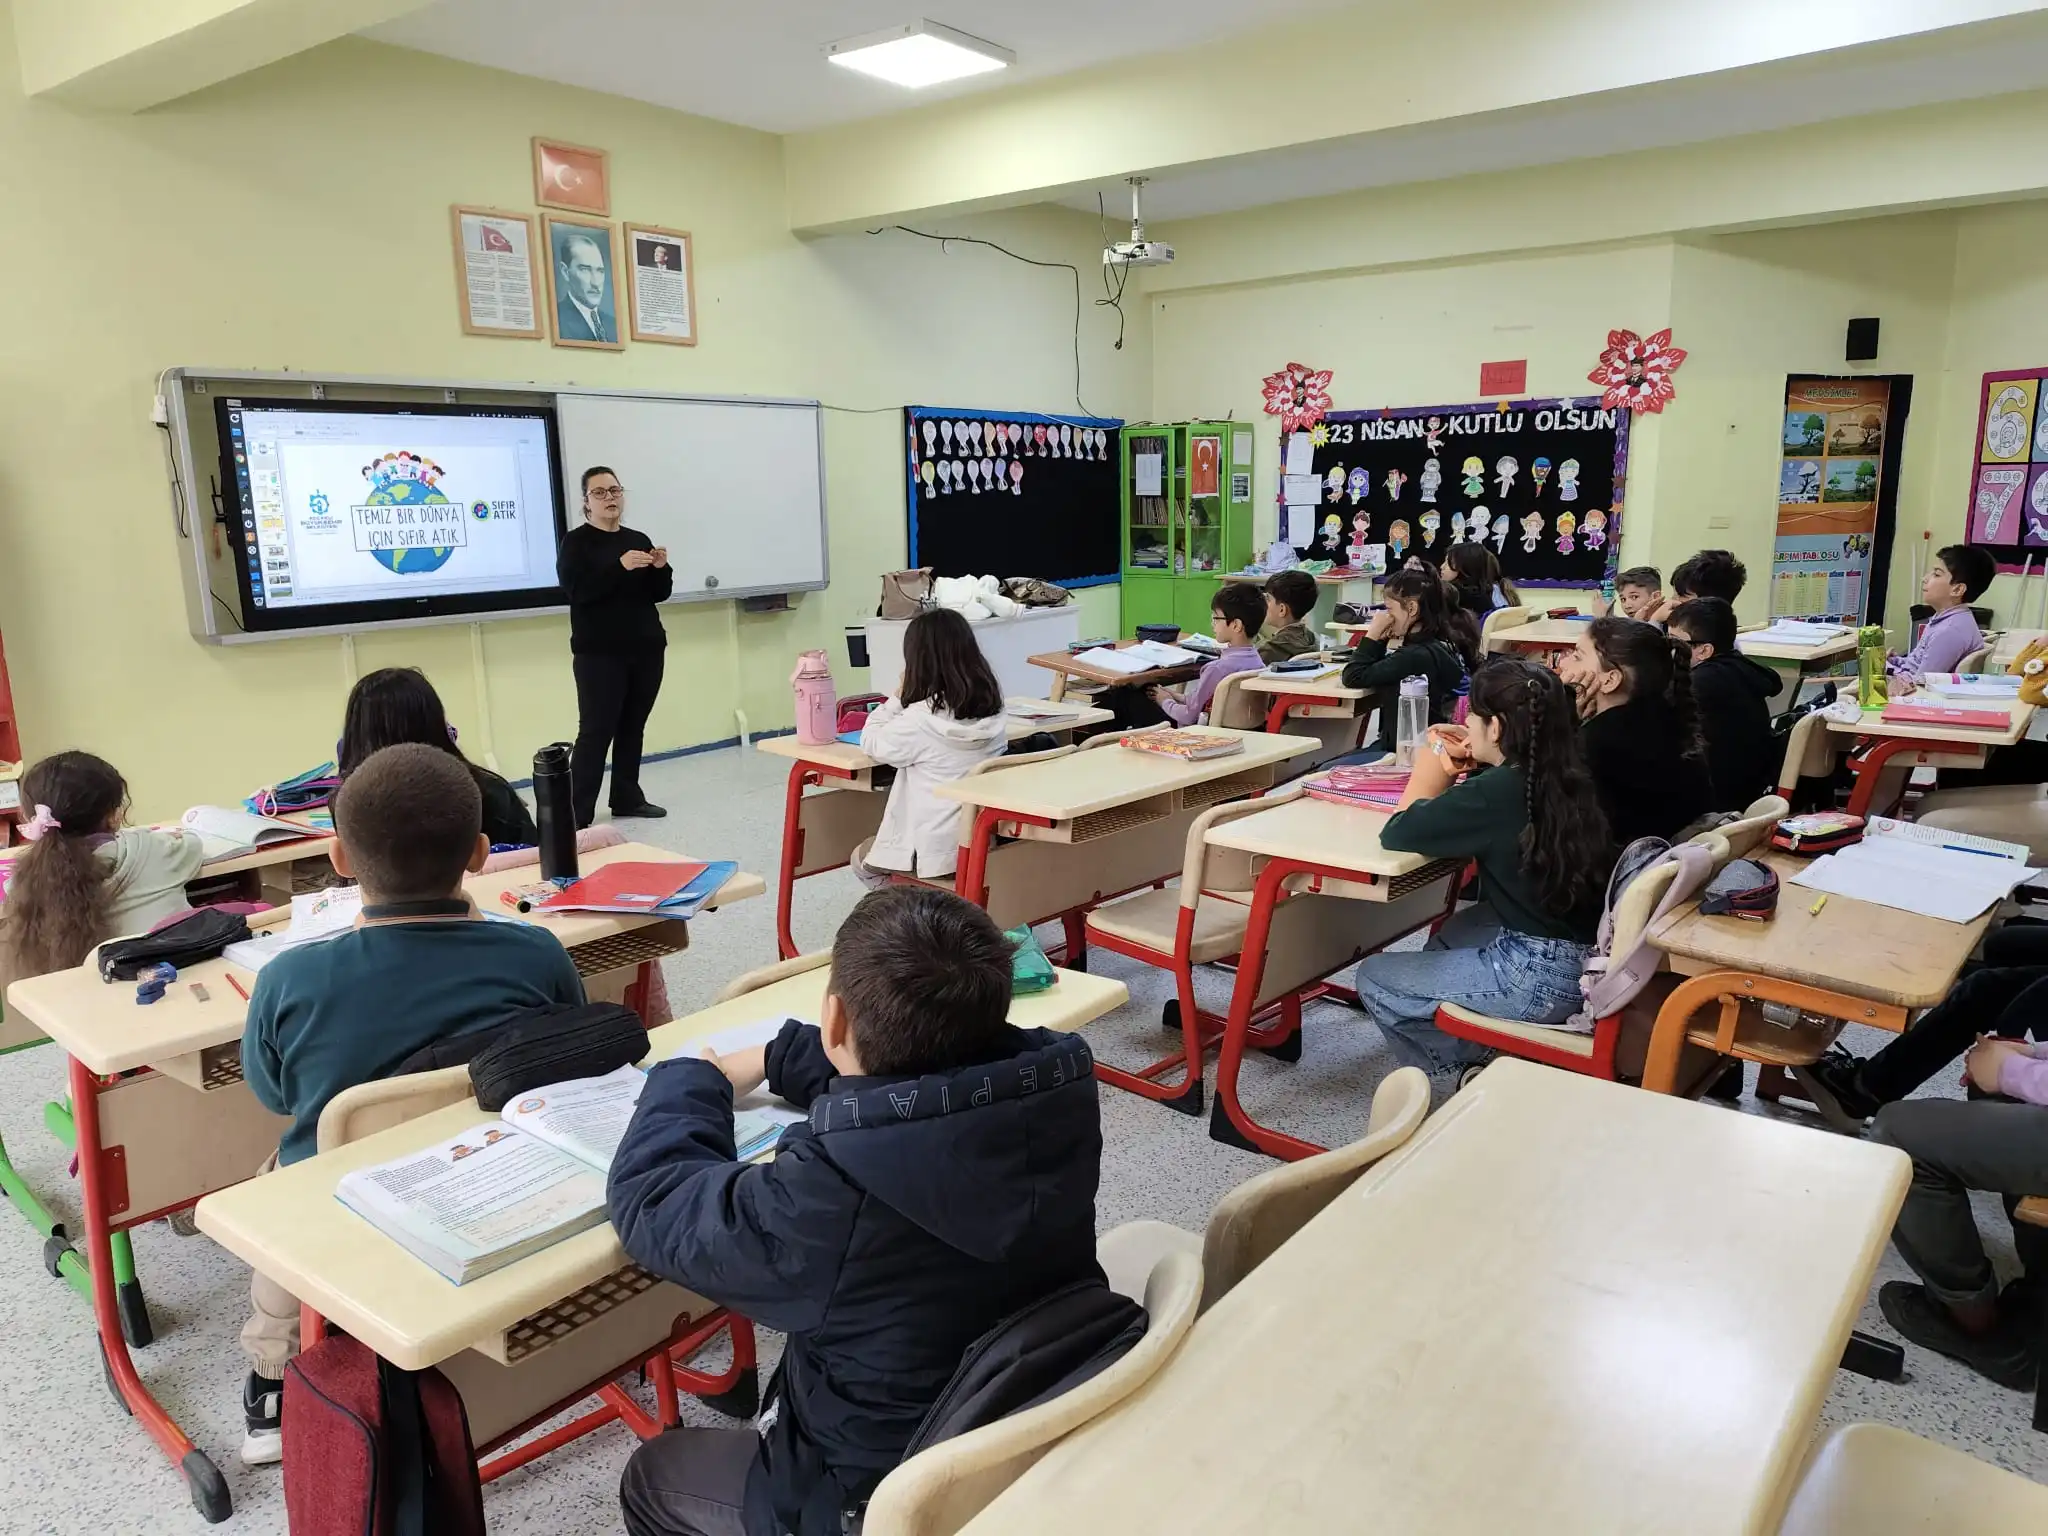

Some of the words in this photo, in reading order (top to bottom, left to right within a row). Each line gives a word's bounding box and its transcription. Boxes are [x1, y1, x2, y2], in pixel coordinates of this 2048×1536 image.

[1329, 424, 1354, 444] 23
[1361, 418, 1423, 441] NİSAN
[1449, 412, 1523, 435] KUTLU
[1534, 409, 1617, 432] OLSUN
[491, 500, 515, 510] SIFIR
[420, 506, 460, 524] DÜNYA
[493, 510, 516, 520] ATIK
[398, 529, 427, 546] SIFIR
[432, 528, 459, 544] ATIK
[1802, 551, 1840, 561] TABLOSU
